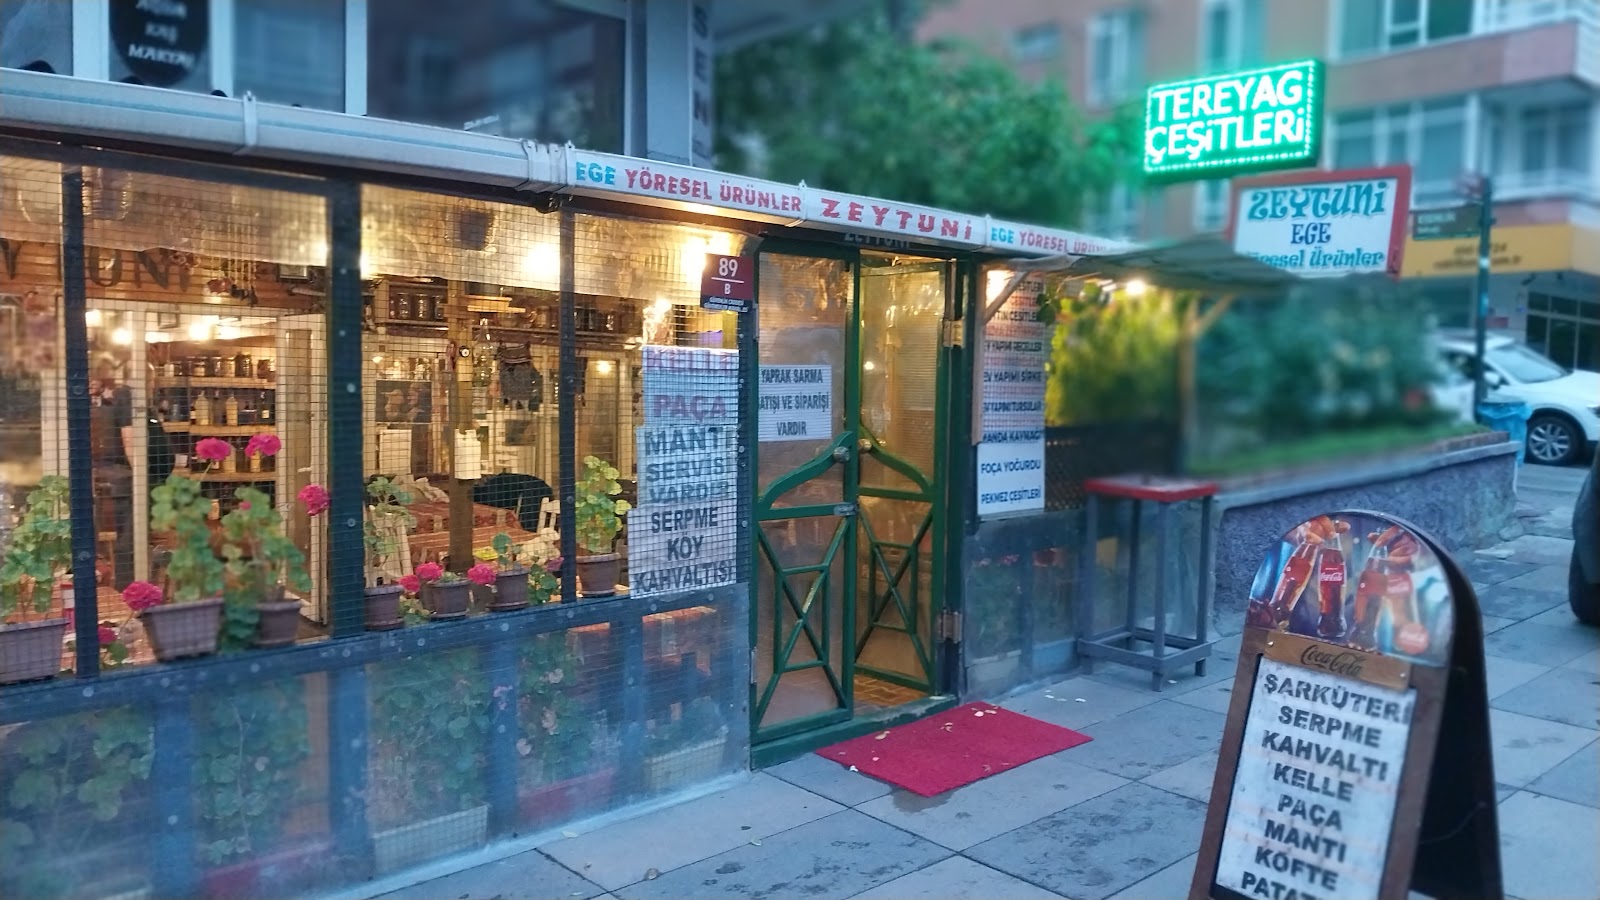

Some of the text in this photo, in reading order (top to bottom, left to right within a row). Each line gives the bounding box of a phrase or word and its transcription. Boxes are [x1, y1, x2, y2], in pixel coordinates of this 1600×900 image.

[1147, 107, 1305, 164] ÇEŞİTLERİ
[575, 162, 802, 212] EGE YÖRESEL ÜRÜNLER
[1248, 182, 1388, 220] ZEYTUNİ
[820, 197, 973, 240] ZEYTUNİ
[991, 227, 1015, 244] EGE
[1290, 223, 1332, 245] EGE
[718, 257, 739, 277] 89
[724, 283, 731, 295] B
[761, 369, 823, 384] YAPRAK SARMA
[653, 394, 727, 423] PAÇA
[760, 391, 829, 414] ATIŞI VE SİPARİŞİ
[776, 421, 807, 436] VARDIR
[981, 457, 1041, 476] FOÇA YOĞURDU
[981, 491, 1009, 504] PEKMEZ
[651, 506, 719, 534] SERPME
[667, 532, 705, 561] KÖY
[633, 560, 734, 594] KAHVALTISI
[1278, 705, 1383, 749] SERPME
[1262, 729, 1389, 781] KAHVALTI
[1273, 762, 1355, 802] KELLE
[1277, 794, 1343, 831] PAÇA
[1264, 819, 1347, 863] MANTI
